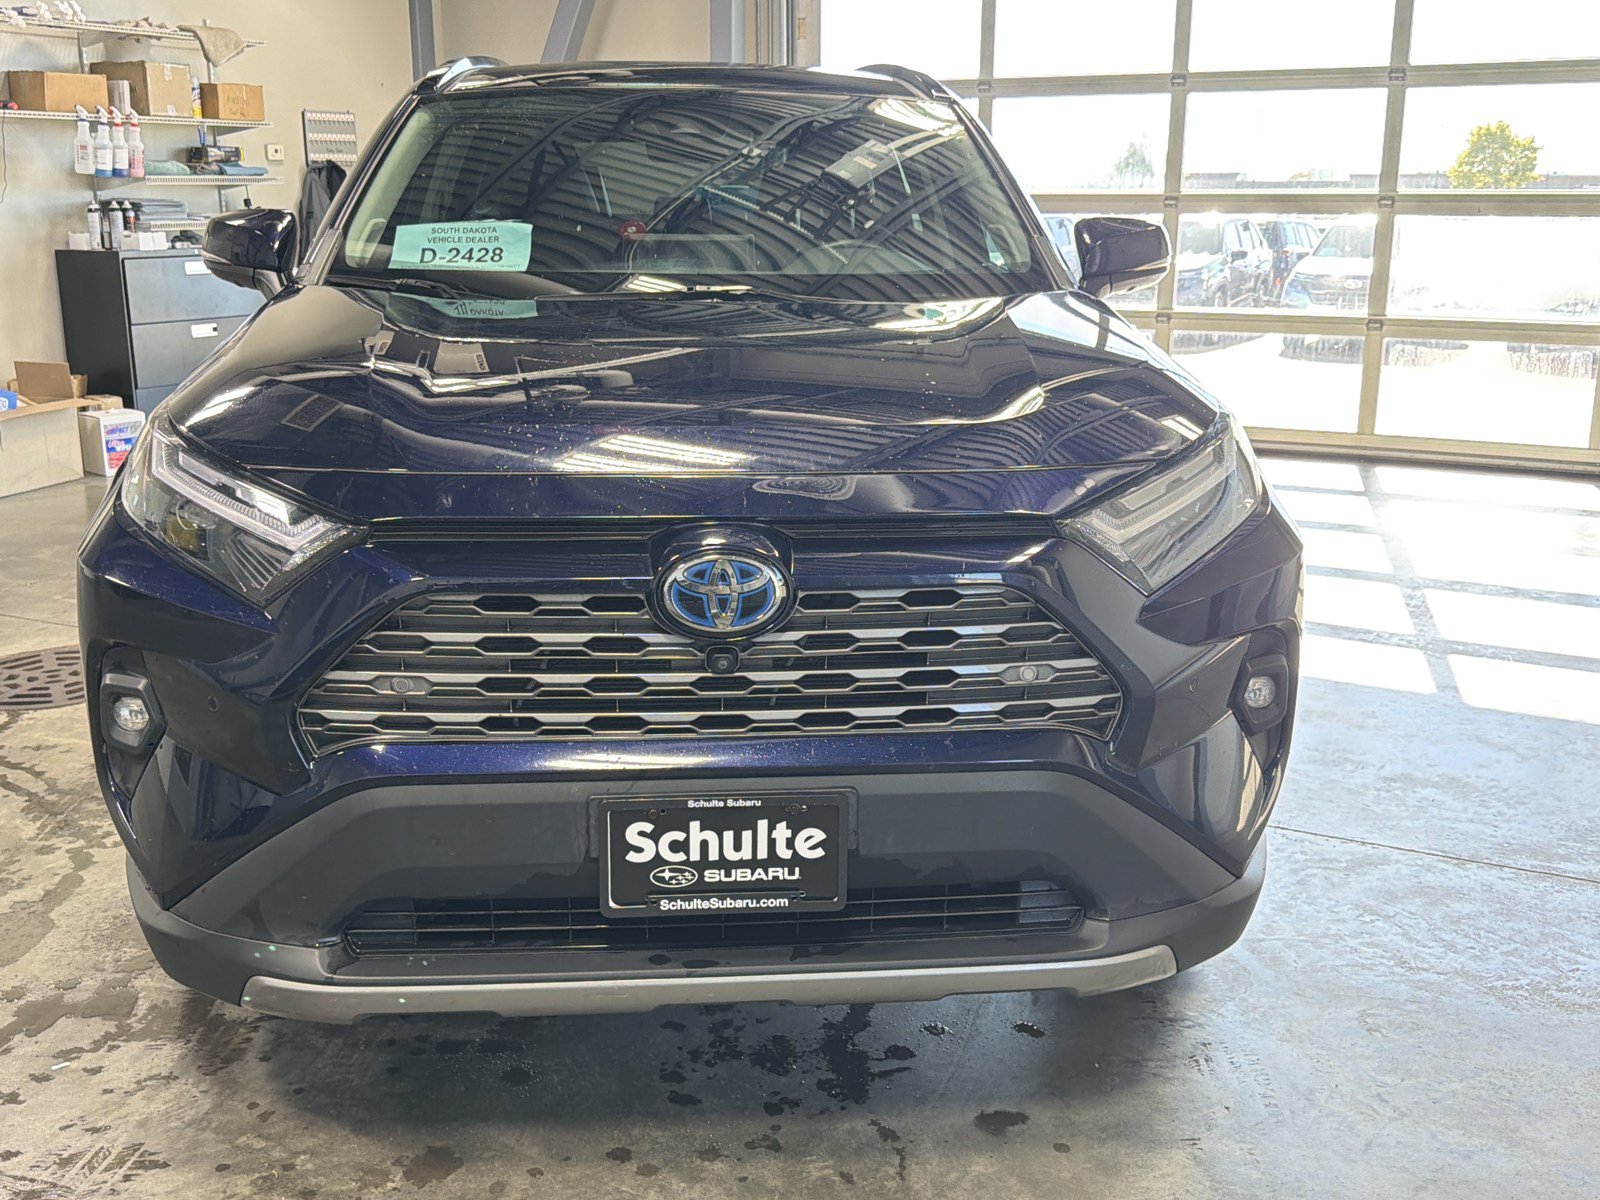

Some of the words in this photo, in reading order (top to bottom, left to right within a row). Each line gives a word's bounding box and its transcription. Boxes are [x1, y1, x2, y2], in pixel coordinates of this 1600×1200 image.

[462, 226, 498, 234] DAKOTA
[427, 236, 463, 244] VEHICLE
[465, 236, 500, 244] DEALER
[419, 247, 504, 264] D-2428
[687, 799, 724, 808] Schulte
[726, 799, 762, 807] Subaru
[624, 818, 828, 864] Schulte
[703, 867, 800, 882] SUBARU
[659, 897, 789, 911] SchulteSubaru.com
